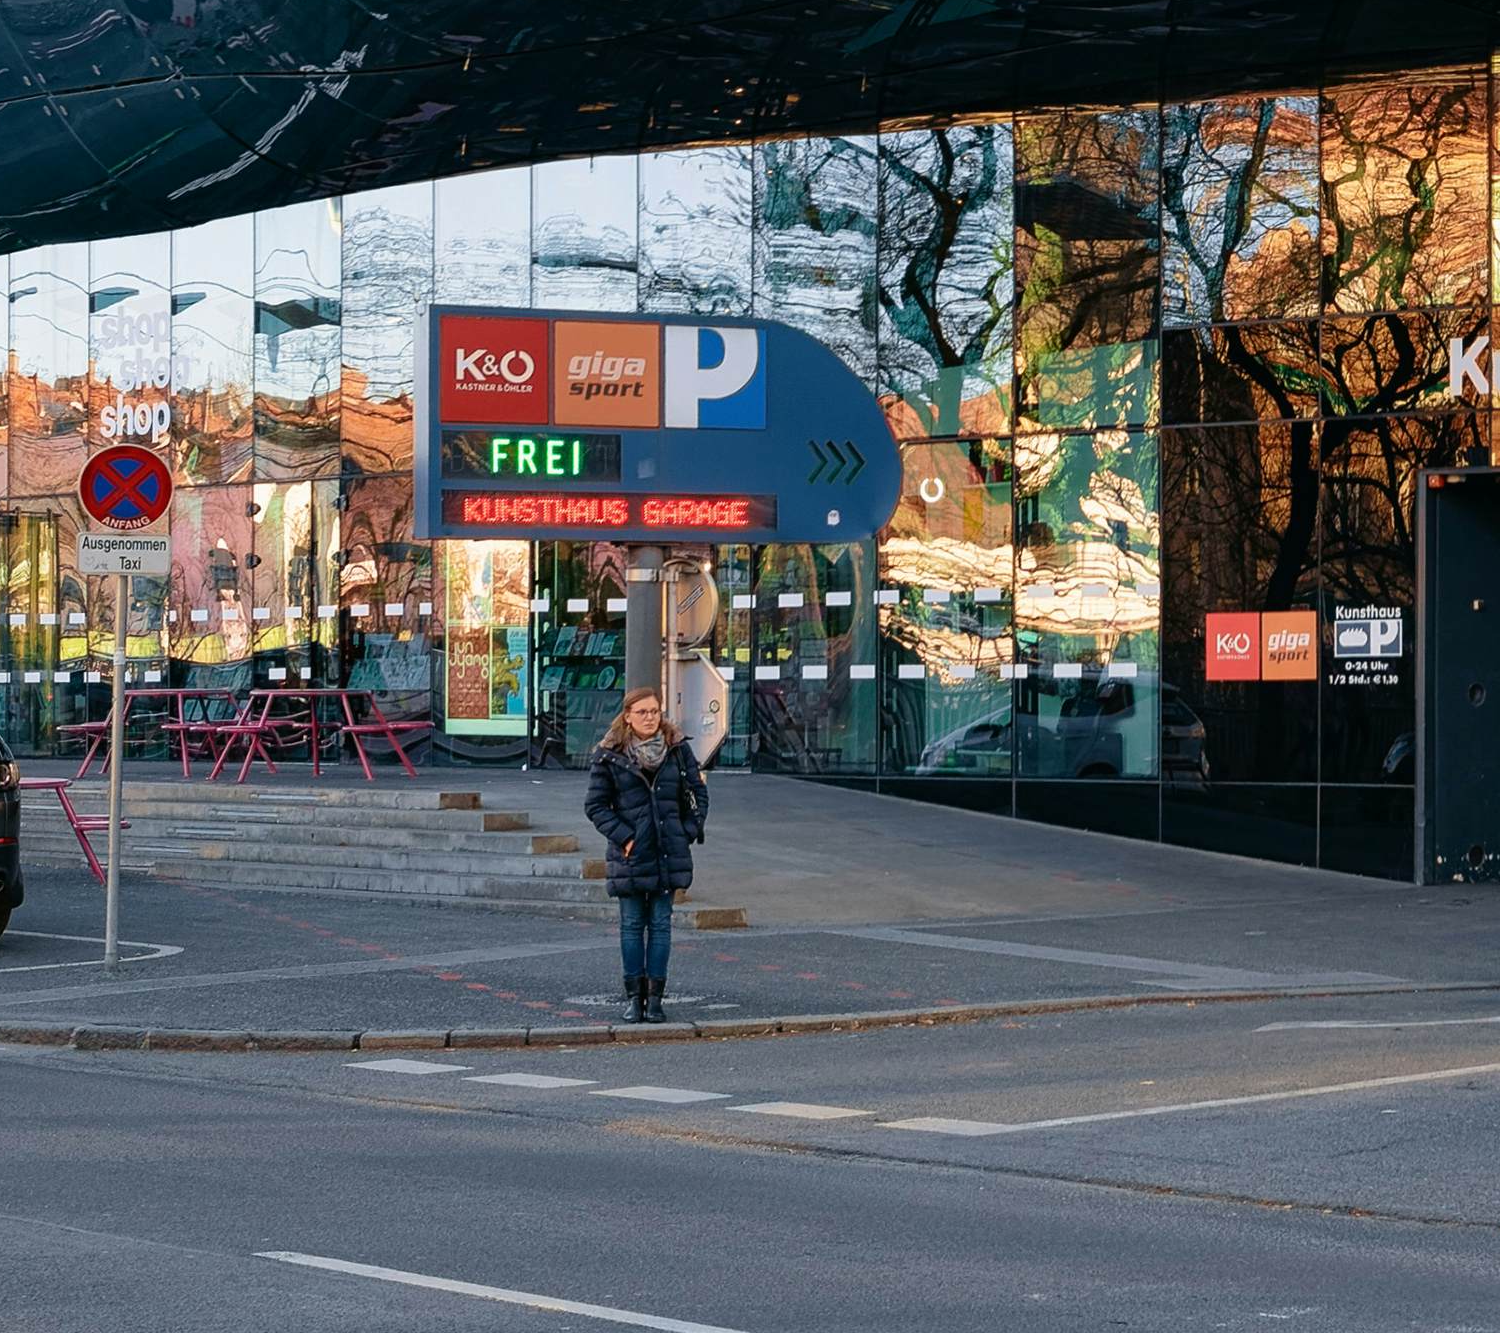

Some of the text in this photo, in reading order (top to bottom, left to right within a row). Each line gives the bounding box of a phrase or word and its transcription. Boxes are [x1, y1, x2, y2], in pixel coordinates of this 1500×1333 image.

[567, 351, 646, 381] giga
[665, 325, 759, 429] P
[455, 383, 497, 392] KASTNER
[568, 382, 645, 400] sport
[100, 394, 171, 444] shop
[491, 438, 581, 476] FREI
[463, 497, 750, 526] KUNSTHAUS GARAGE
[101, 515, 151, 530] ANFANG
[82, 536, 167, 552] Ausgenommen
[119, 555, 142, 571] Taxi
[1336, 604, 1401, 619] Kunsthaus
[1267, 629, 1310, 651] giga
[1268, 650, 1310, 664] sport
[1370, 661, 1389, 671] Uhr
[1328, 674, 1346, 685] 1/2
